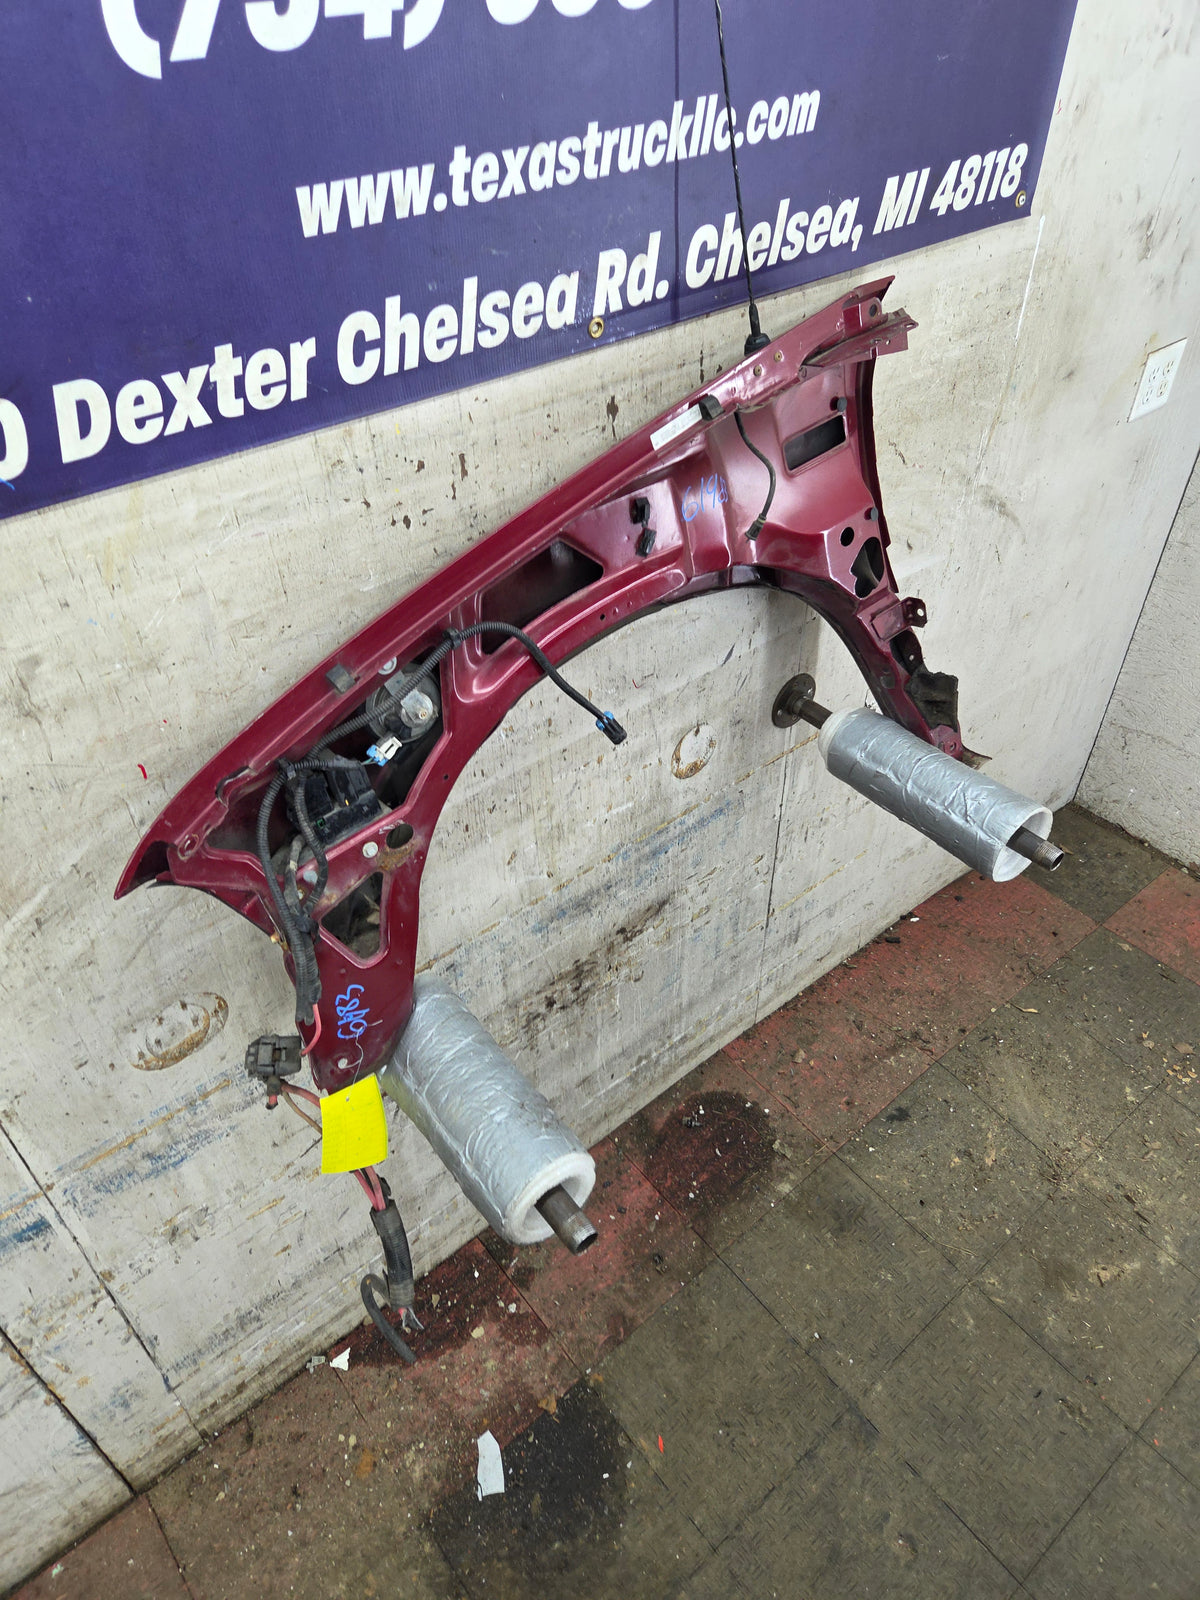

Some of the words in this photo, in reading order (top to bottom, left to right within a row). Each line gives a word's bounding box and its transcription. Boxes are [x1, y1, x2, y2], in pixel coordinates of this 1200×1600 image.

[296, 89, 821, 238] www.texastruckllc.com
[52, 336, 317, 465] Dexter
[337, 270, 579, 386] Chelsea
[593, 231, 670, 317] Rd.
[685, 196, 862, 290] Chelsea,
[872, 167, 931, 236] MI
[928, 143, 1029, 217] 48118
